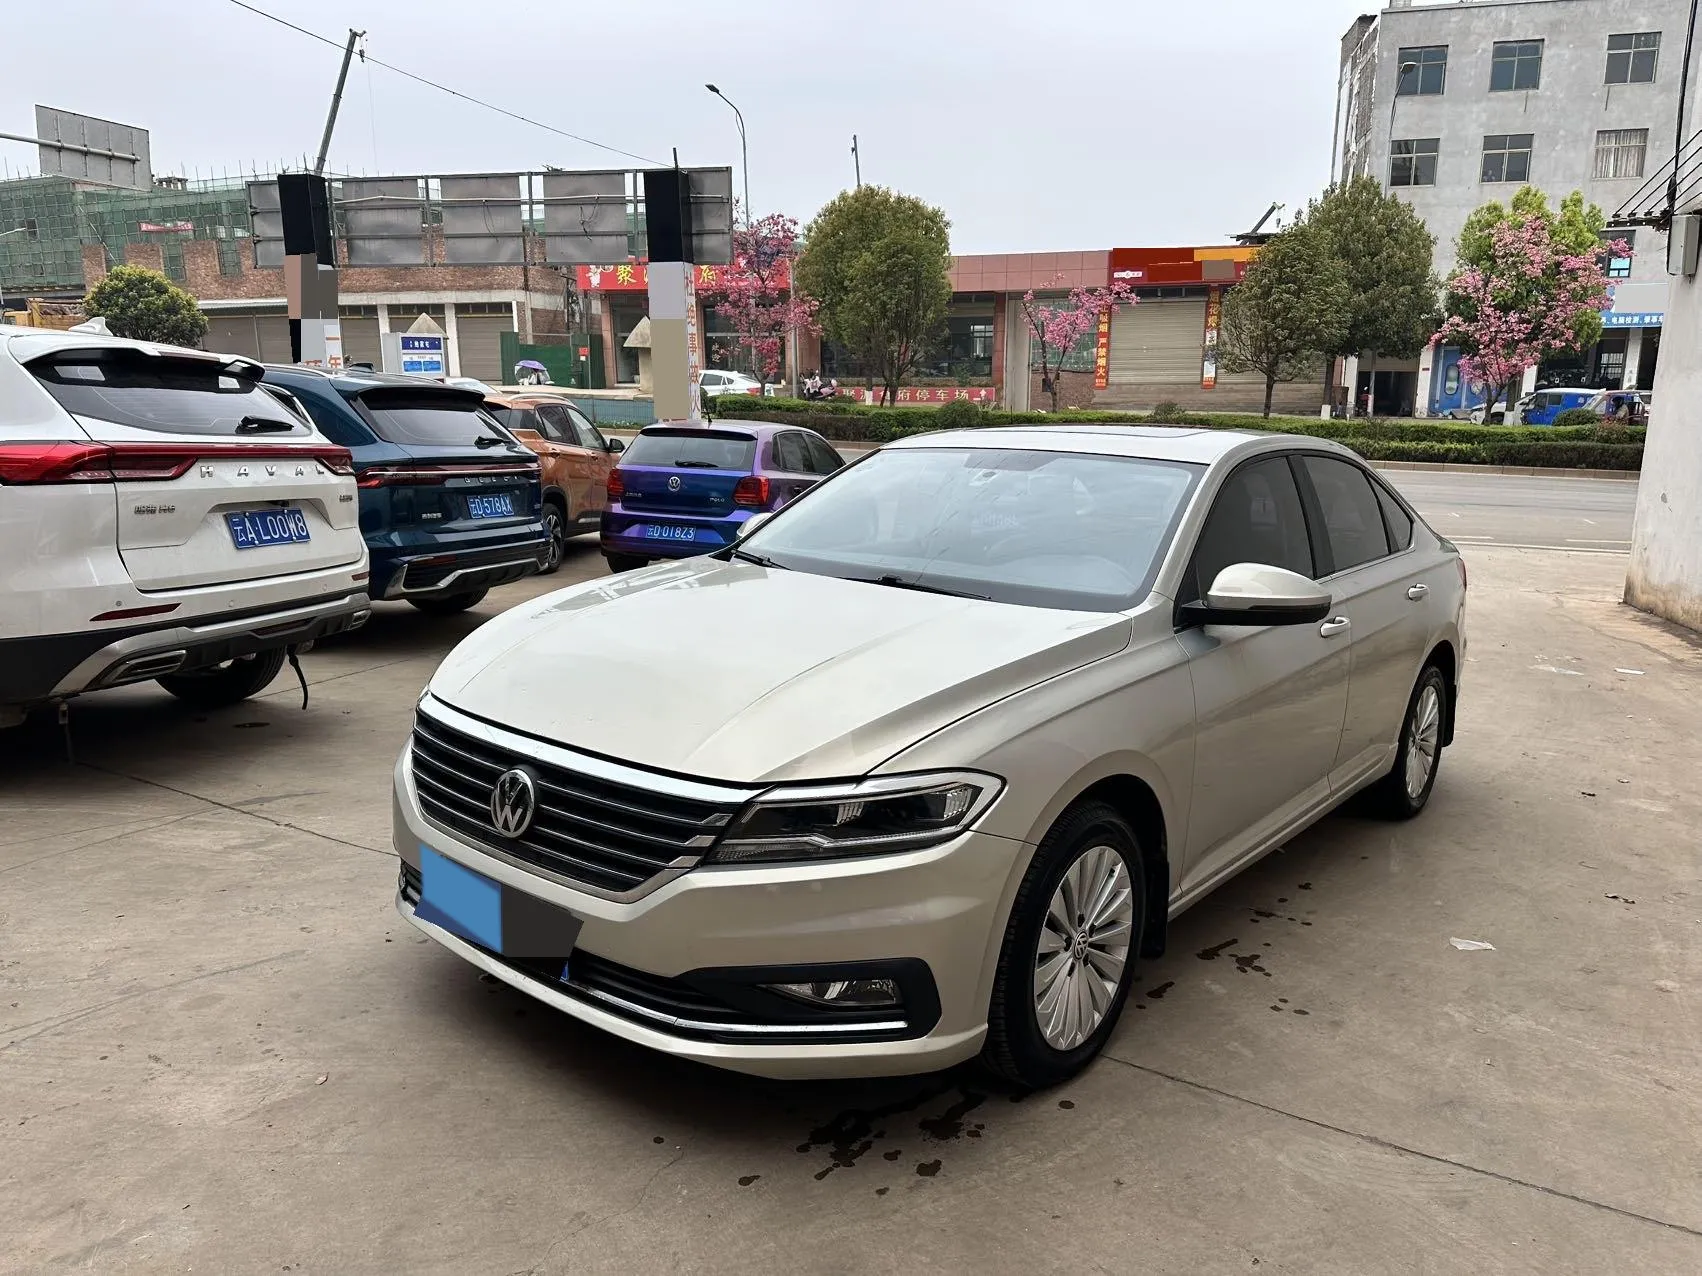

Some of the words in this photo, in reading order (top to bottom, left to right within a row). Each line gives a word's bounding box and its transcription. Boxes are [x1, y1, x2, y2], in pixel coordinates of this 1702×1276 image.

[1096, 337, 1108, 376] 严禁烟火
[200, 464, 325, 479] HAVAL
